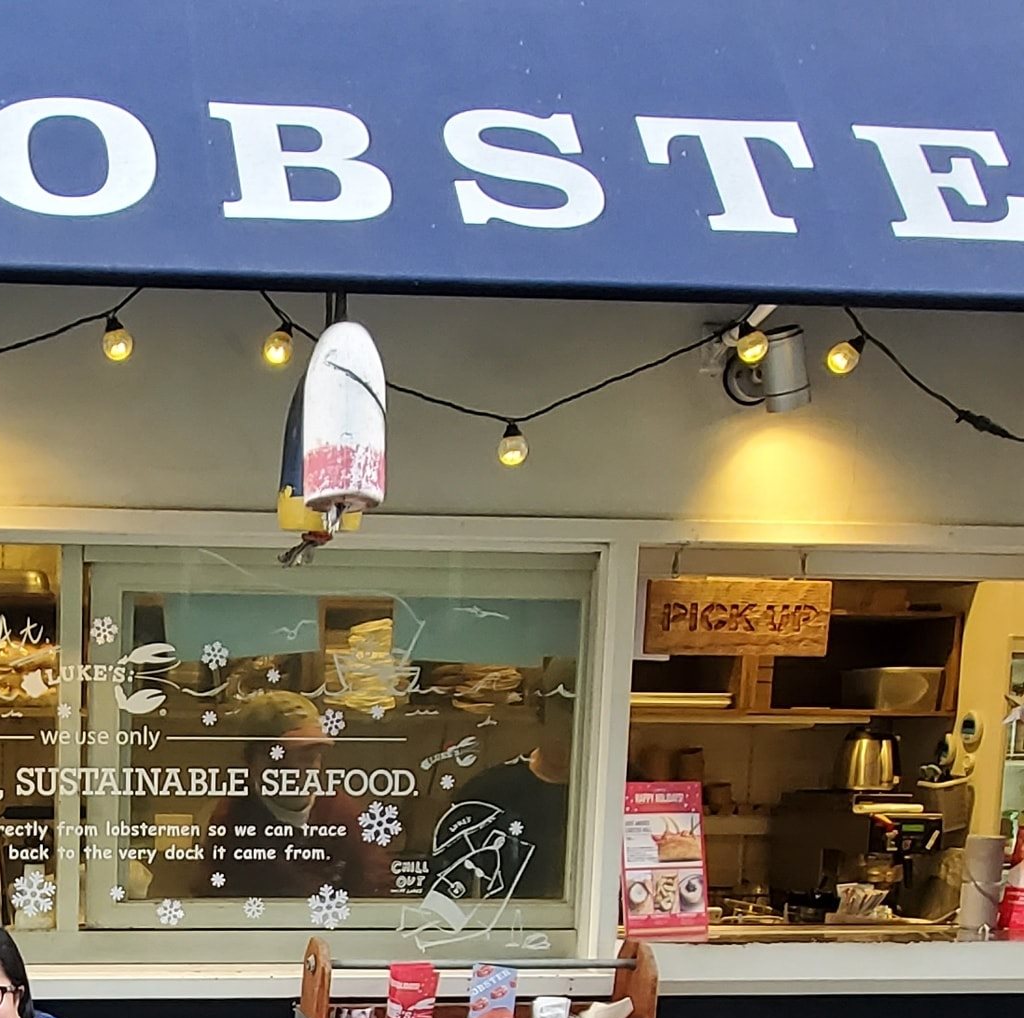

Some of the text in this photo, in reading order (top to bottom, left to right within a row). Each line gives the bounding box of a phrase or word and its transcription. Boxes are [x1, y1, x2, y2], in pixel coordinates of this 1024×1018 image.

[661, 602, 820, 632] PICK UP
[40, 725, 161, 750] we use only
[16, 767, 249, 797] SUSTAINABLE
[262, 768, 419, 797] SEAFOOD.
[57, 820, 98, 837] from
[106, 820, 200, 837] lobstermen
[208, 825, 227, 837] so
[234, 825, 257, 837] we
[264, 825, 294, 837] can
[301, 823, 347, 837] trace
[8, 844, 49, 861] back
[59, 847, 75, 860] to
[83, 844, 113, 860] the
[119, 848, 157, 864] very
[165, 844, 205, 861] dock
[212, 845, 227, 861] it
[233, 848, 277, 861] came
[284, 844, 331, 861] from.
[390, 860, 430, 875] CHILL
[395, 875, 427, 889] OUT
